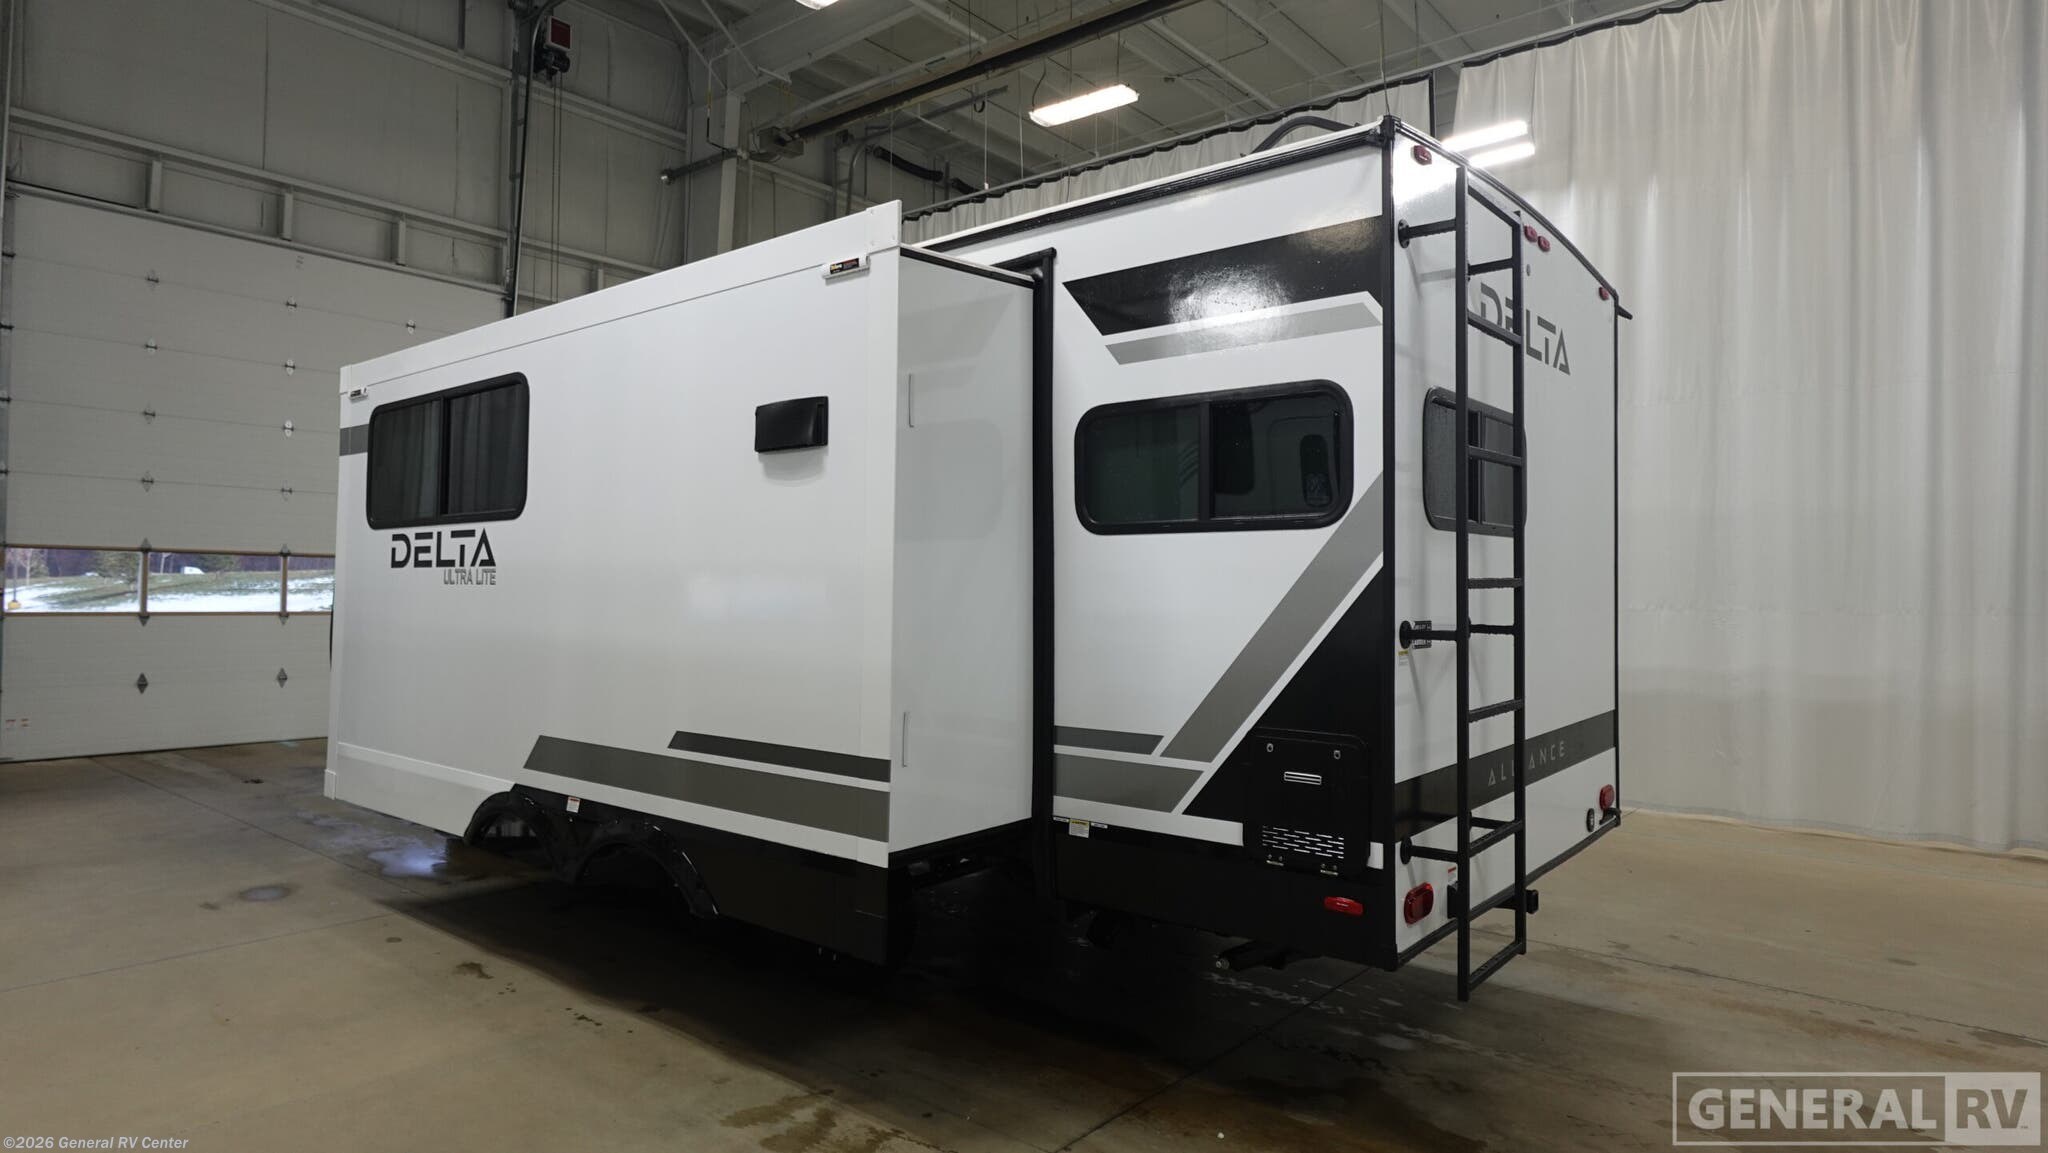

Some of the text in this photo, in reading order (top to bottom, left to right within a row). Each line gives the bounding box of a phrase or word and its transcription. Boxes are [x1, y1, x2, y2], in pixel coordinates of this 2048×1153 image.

[391, 528, 496, 568] DELTA
[443, 568, 497, 586] ULTRA LITE
